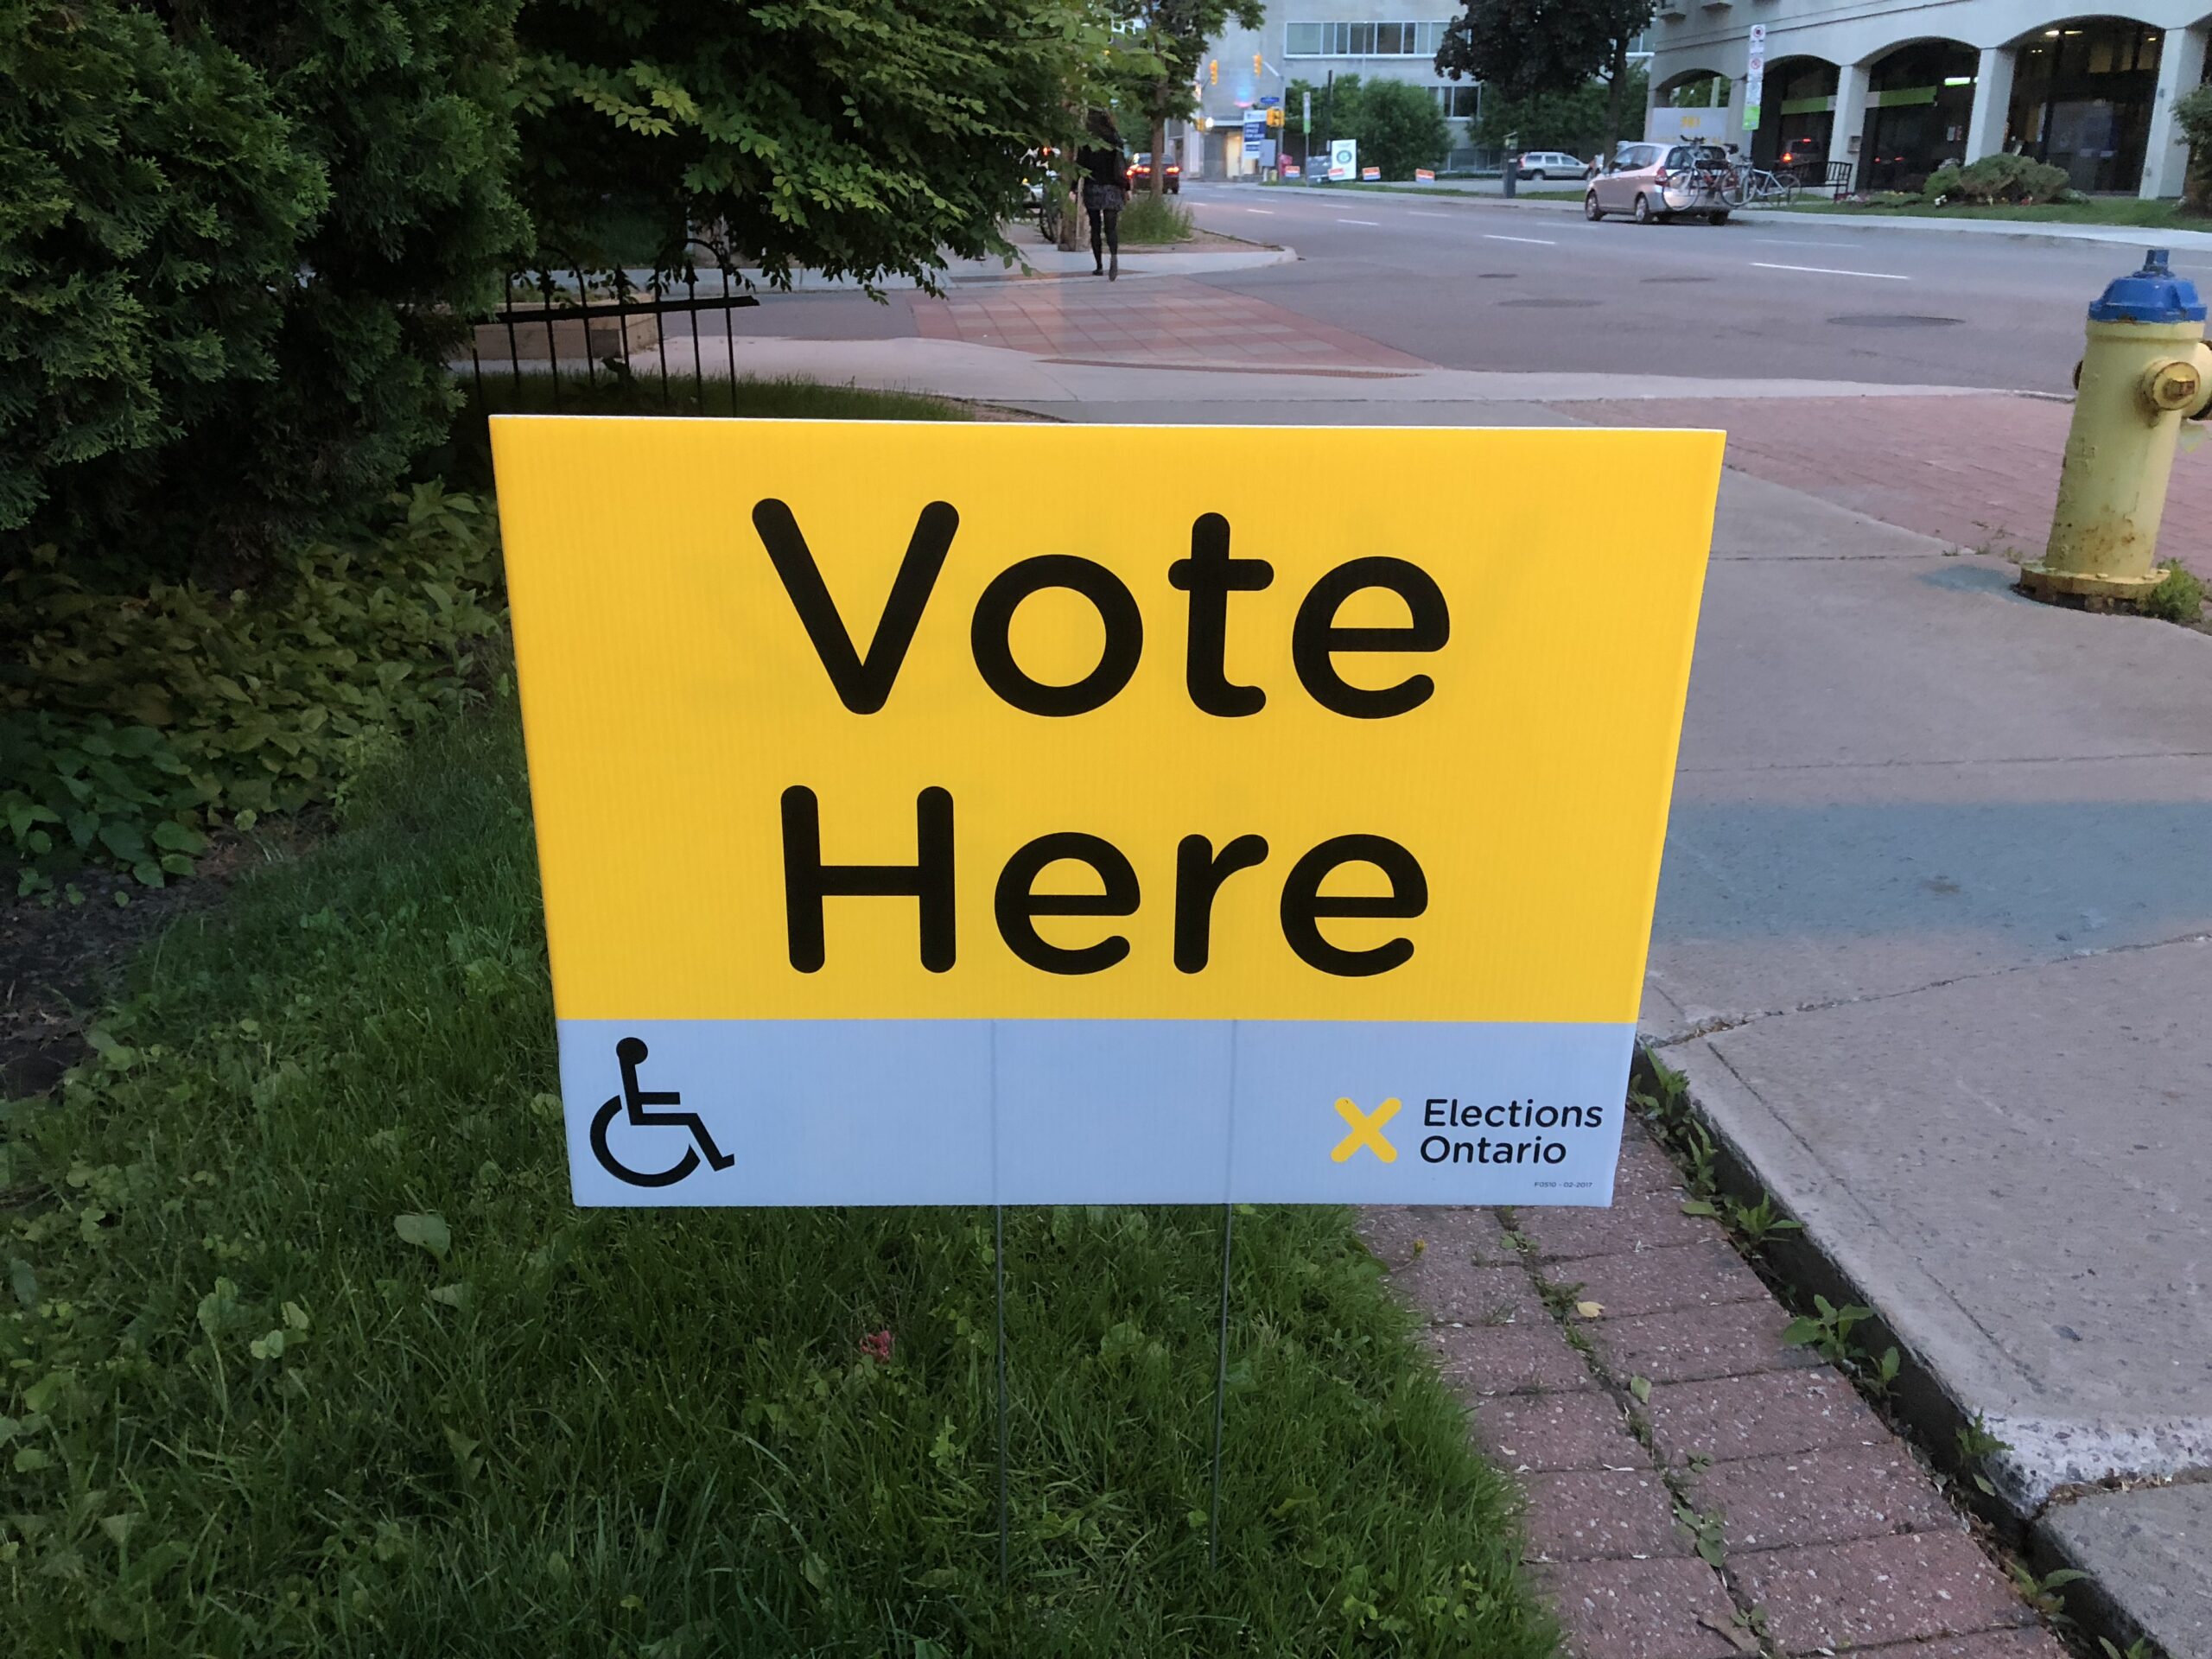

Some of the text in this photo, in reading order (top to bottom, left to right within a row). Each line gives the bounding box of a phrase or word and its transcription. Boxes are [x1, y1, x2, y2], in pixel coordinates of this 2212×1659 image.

[752, 499, 1450, 720] Vote
[781, 785, 1428, 976] Here
[1420, 1135, 1567, 1165] Ontario
[1424, 1098, 1604, 1128] Elections
